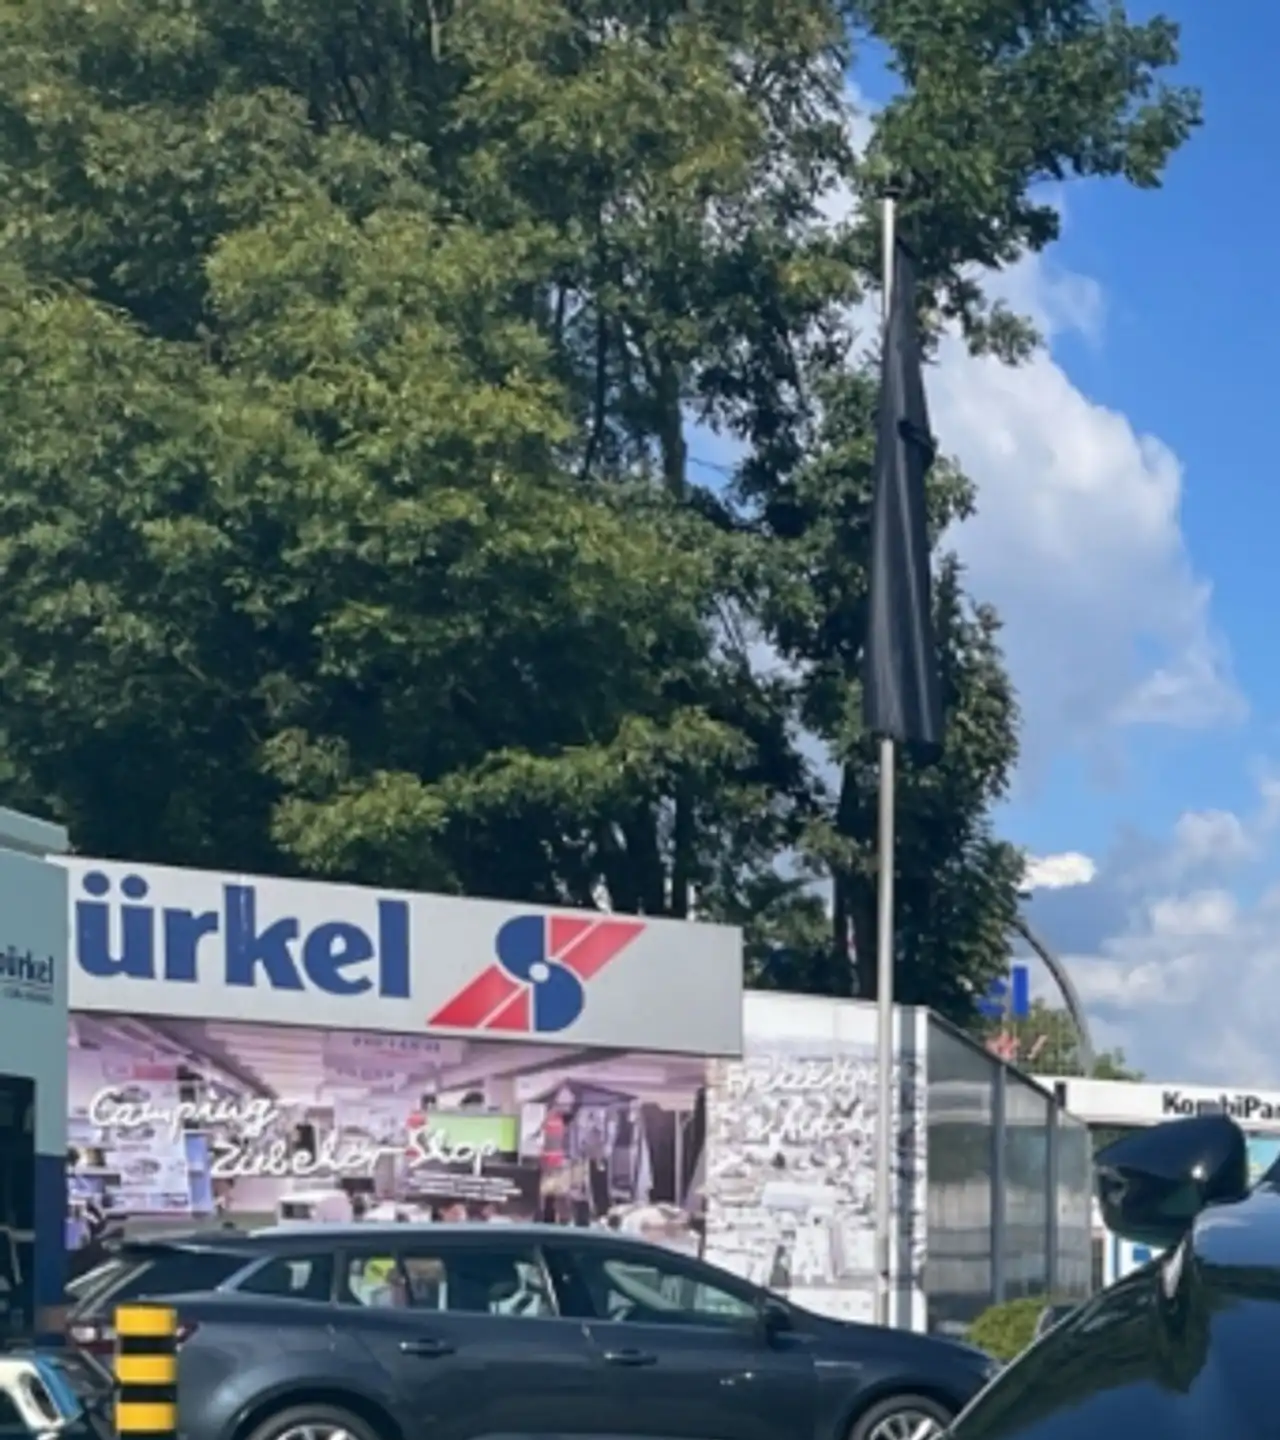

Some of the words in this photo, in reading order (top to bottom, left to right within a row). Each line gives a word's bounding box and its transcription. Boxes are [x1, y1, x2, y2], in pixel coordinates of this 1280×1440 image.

[75, 871, 410, 998] ürkel
[90, 1083, 278, 1143] Camping
[409, 1126, 498, 1177] Shop
